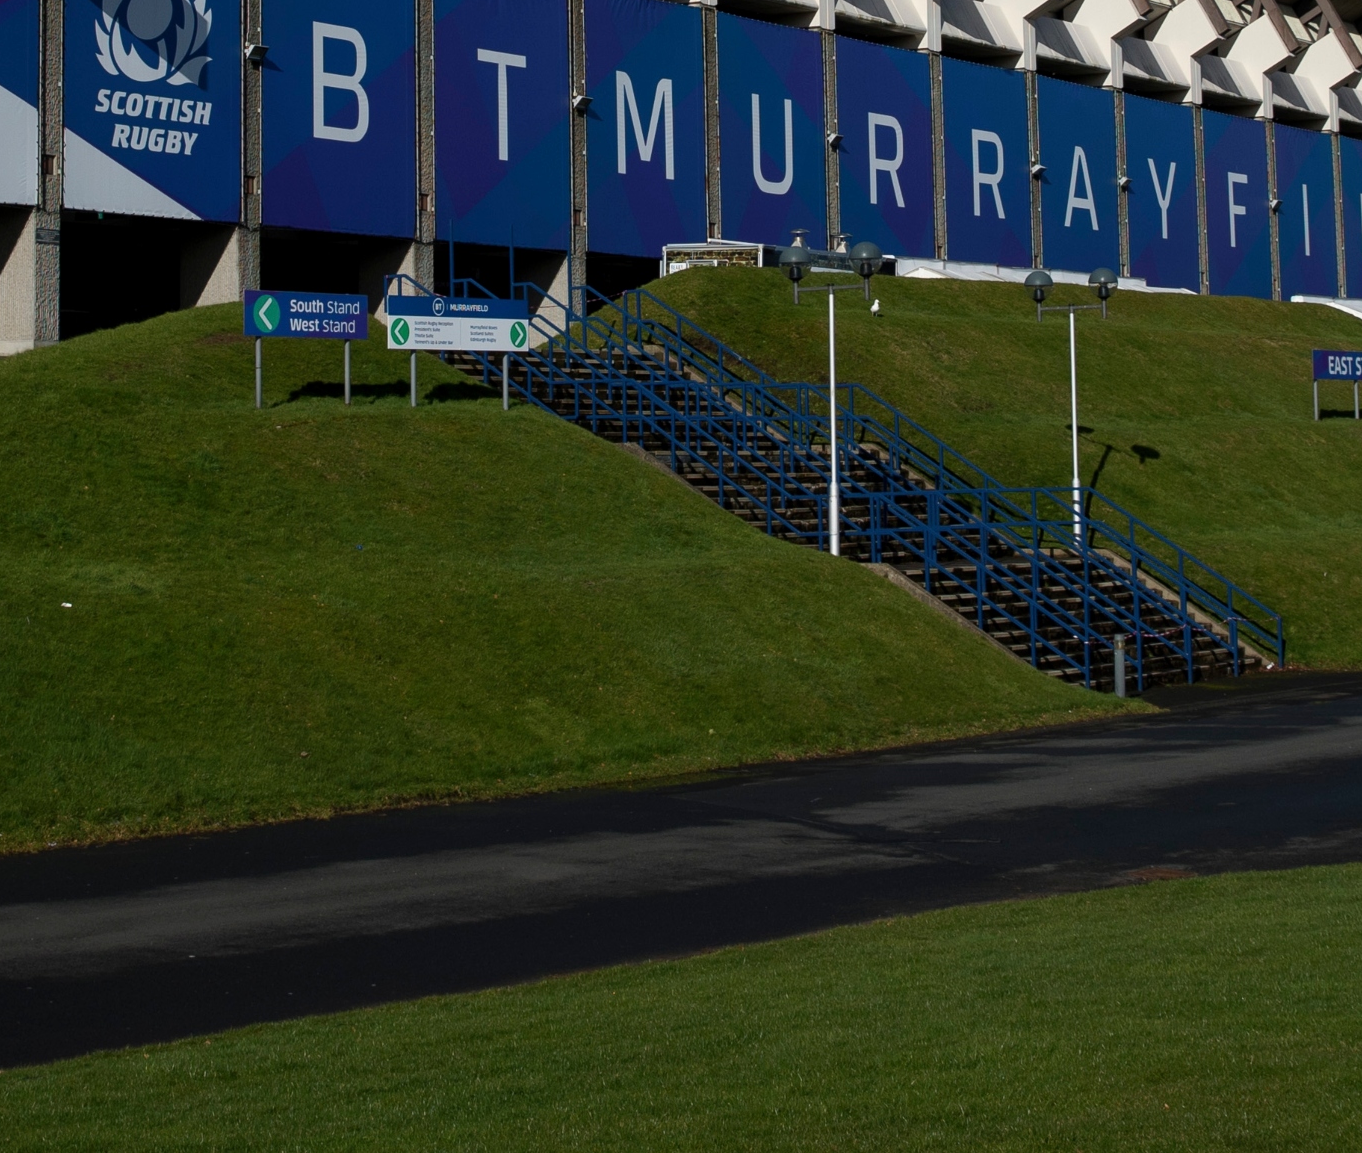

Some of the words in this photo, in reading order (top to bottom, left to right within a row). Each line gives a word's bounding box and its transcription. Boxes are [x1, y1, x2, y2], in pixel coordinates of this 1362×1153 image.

[94, 88, 213, 126] SCOTTISH
[111, 123, 199, 157] RUGBY
[290, 299, 324, 314] South
[327, 300, 360, 315] Stand
[435, 303, 442, 311] BT
[449, 303, 489, 313] MURRAYFIELD
[289, 318, 320, 333] West
[322, 319, 356, 334] Stand
[1328, 355, 1353, 376] EAST
